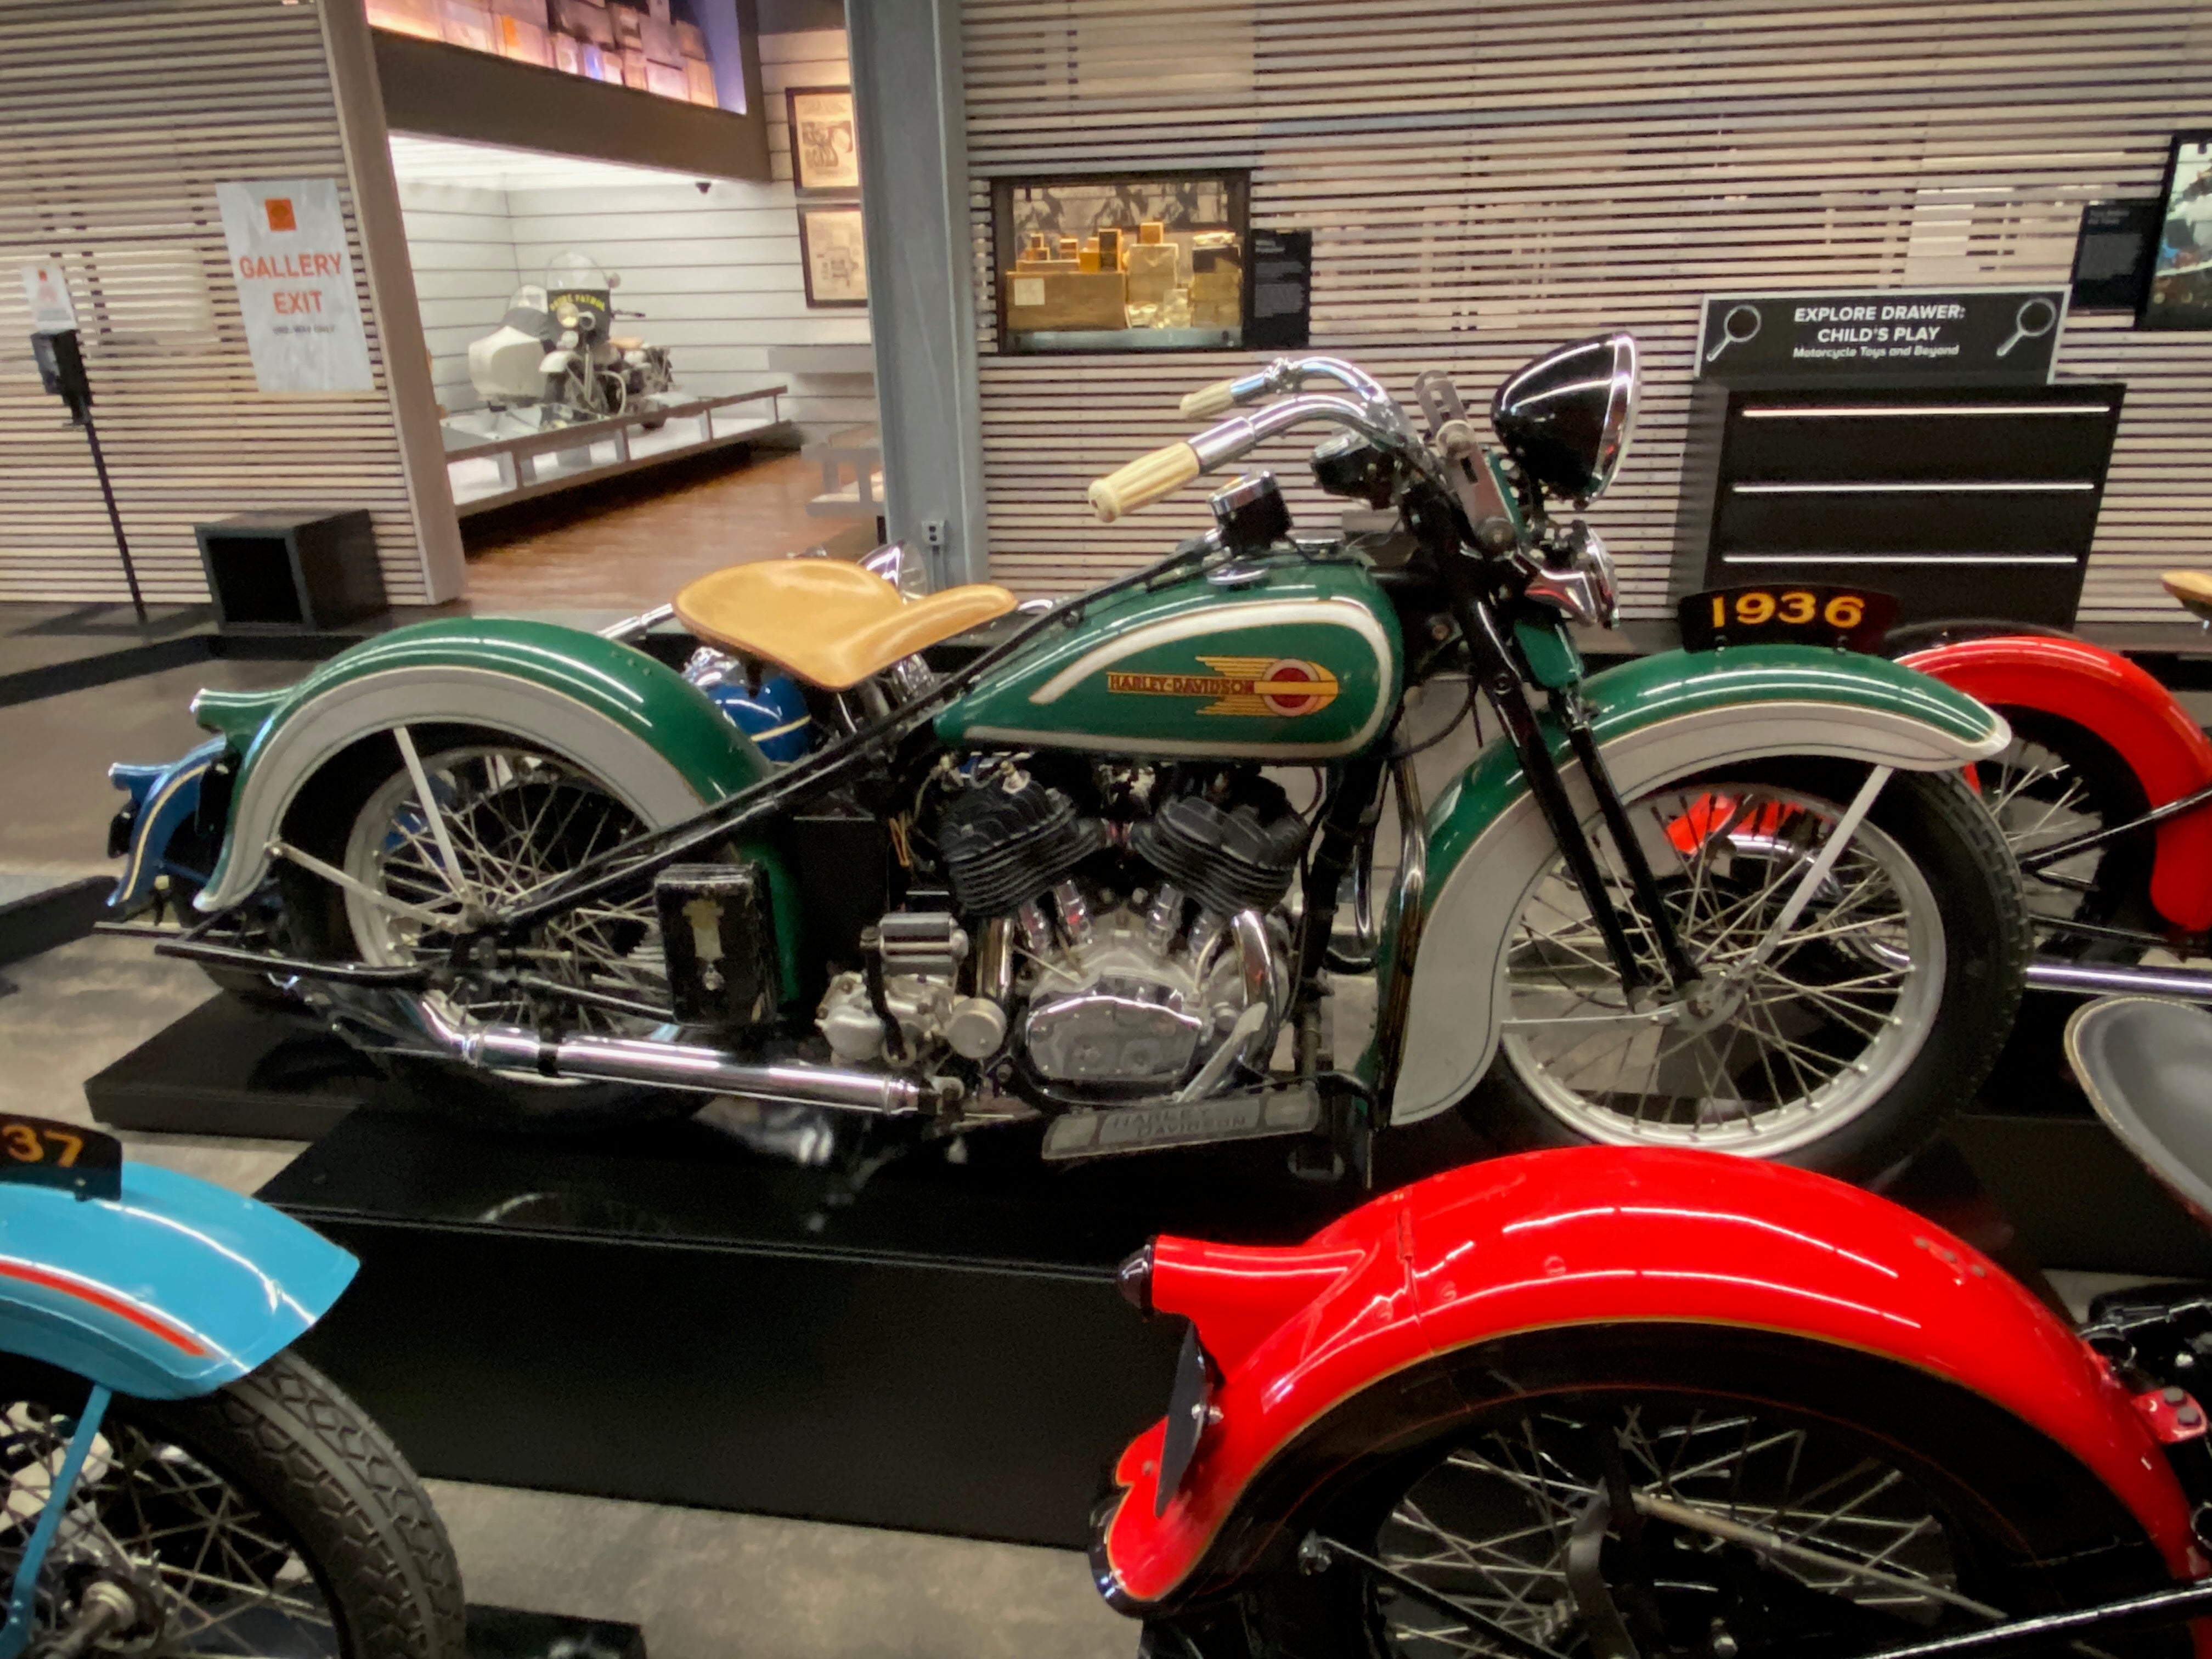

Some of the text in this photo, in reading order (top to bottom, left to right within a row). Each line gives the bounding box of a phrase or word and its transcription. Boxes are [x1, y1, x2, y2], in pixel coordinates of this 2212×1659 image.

[239, 253, 341, 279] GALLERY
[273, 289, 322, 315] EXIT
[1794, 305, 1966, 322] EXPLORE DRAWER:
[1818, 326, 1940, 343] CHILD'S PLAY
[1793, 345, 1960, 359] Motorcycle Toys and Beyond
[1712, 591, 1865, 628] 1936
[1114, 1108, 1209, 1128] HARLEY
[2, 1125, 83, 1168] 37
